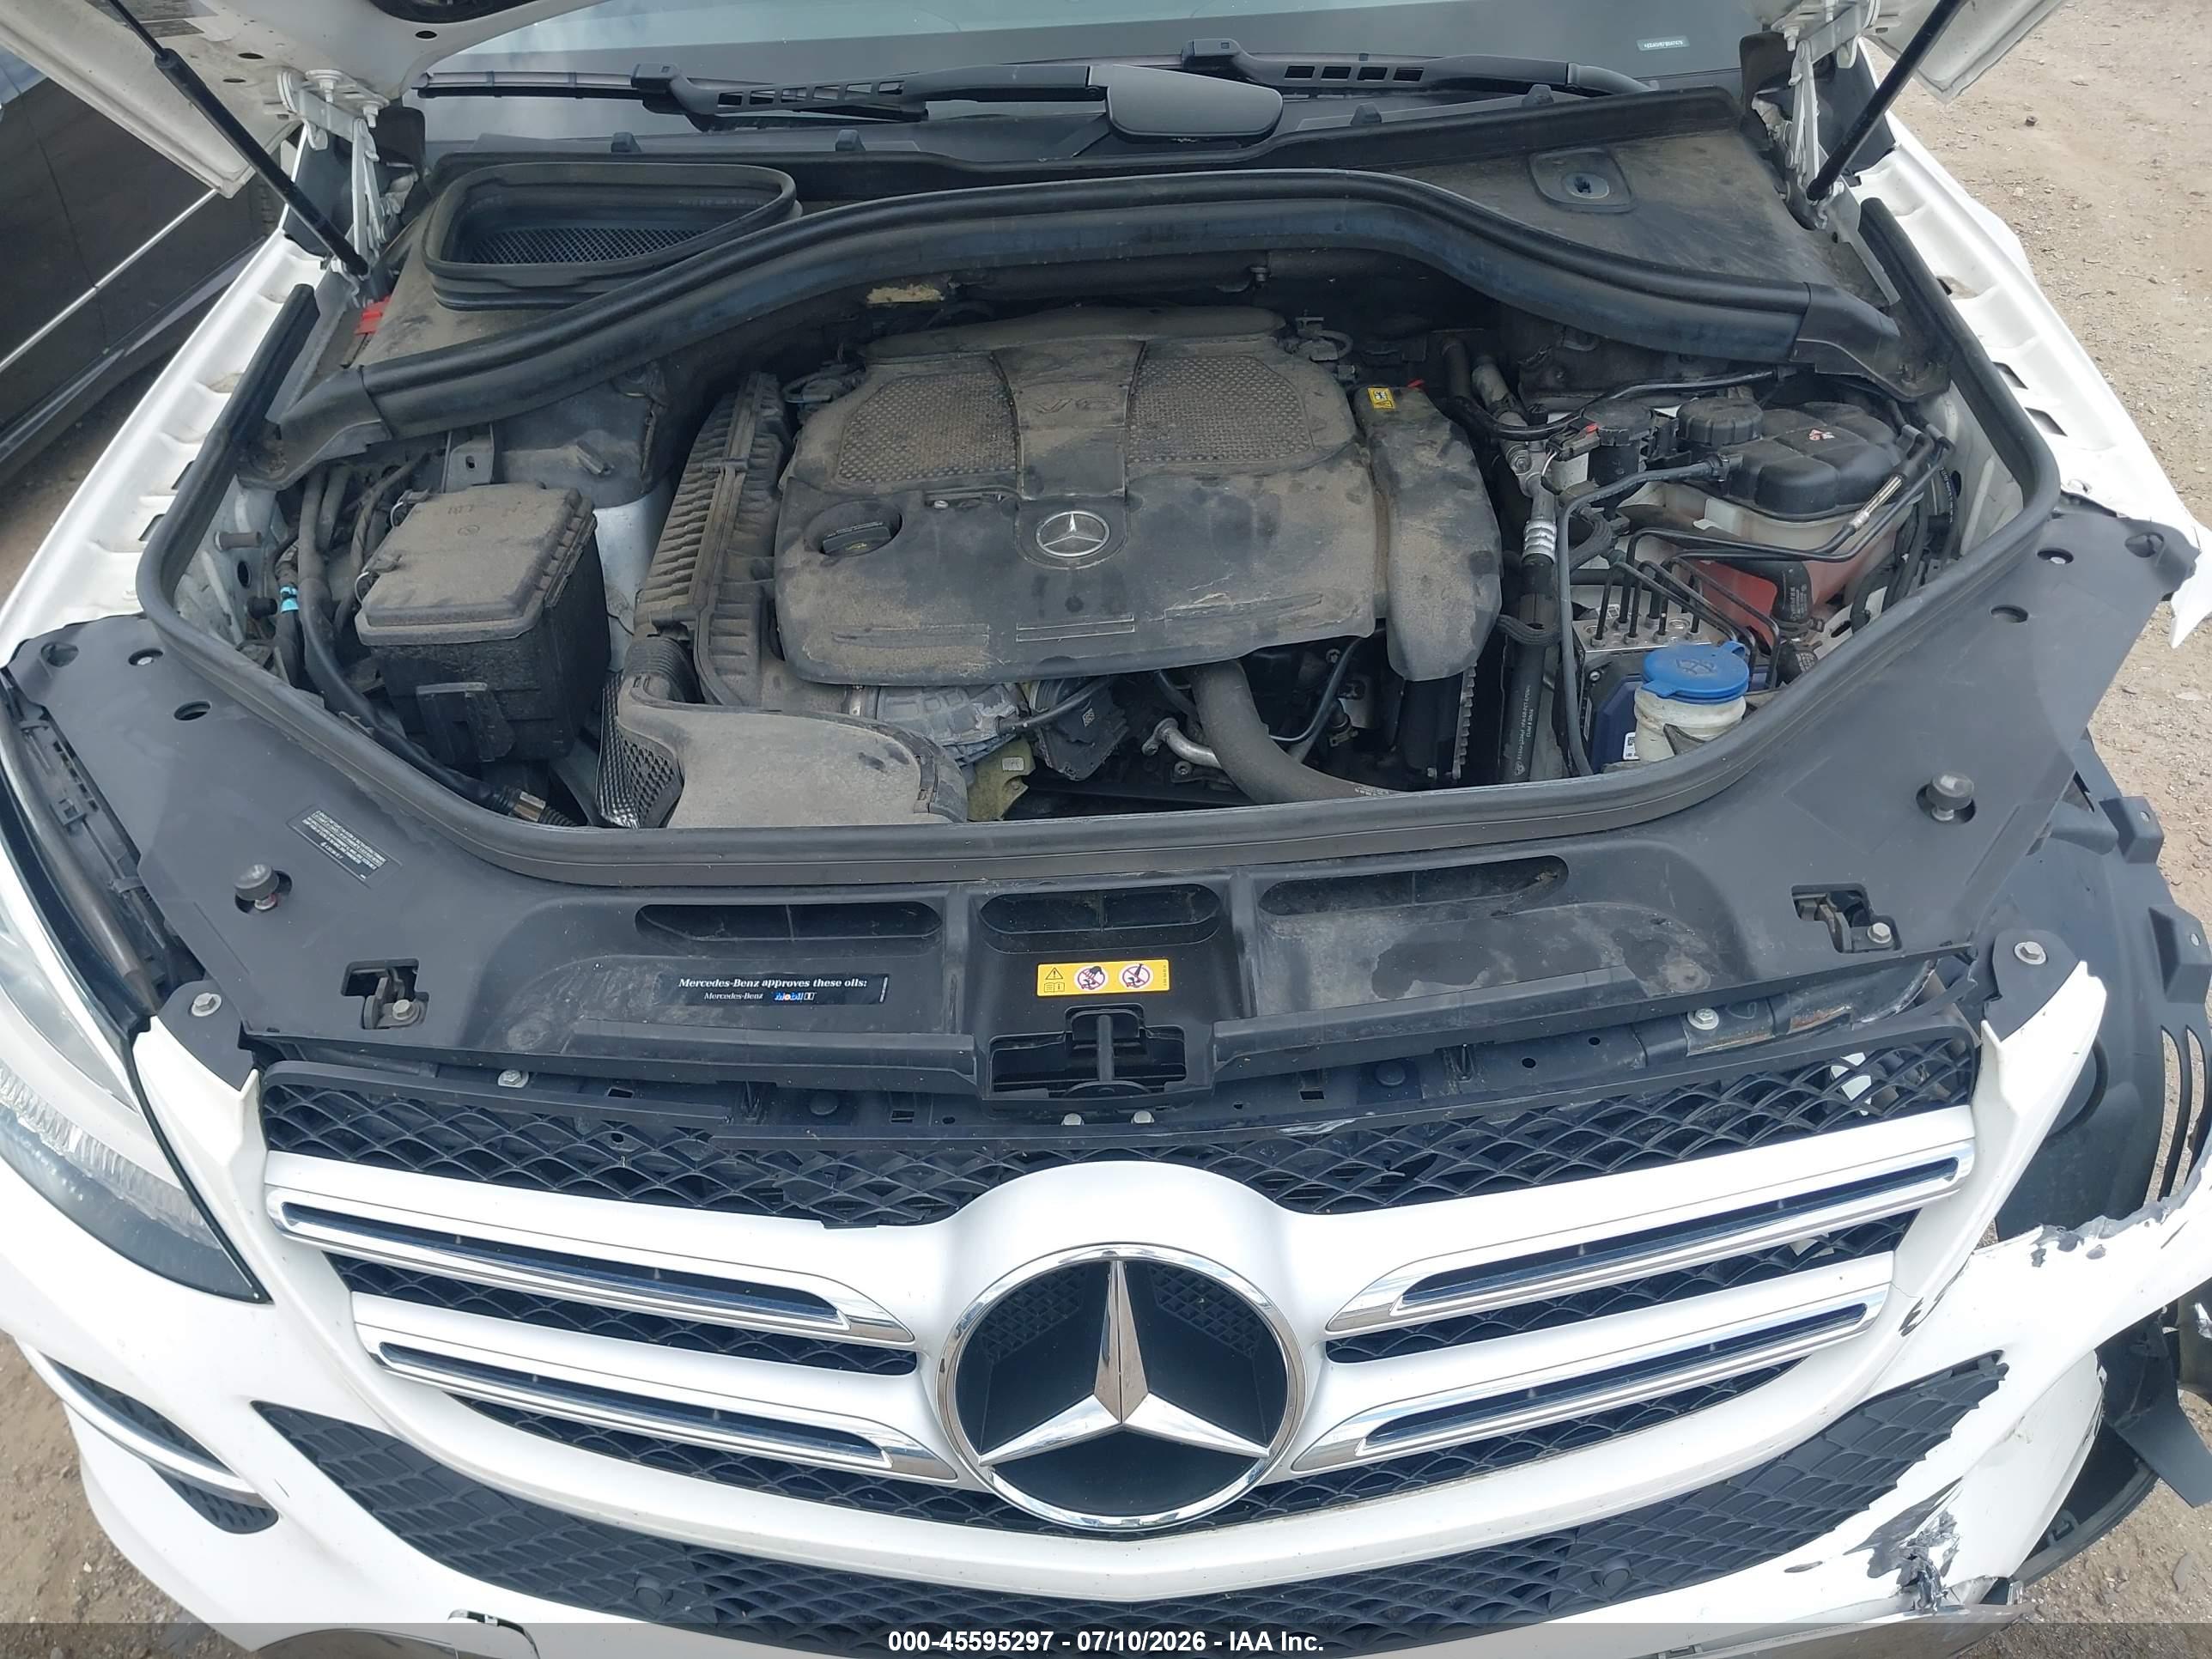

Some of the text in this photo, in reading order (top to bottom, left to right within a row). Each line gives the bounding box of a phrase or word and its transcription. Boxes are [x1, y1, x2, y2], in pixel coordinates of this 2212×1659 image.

[678, 977, 867, 990] Mercedes-Benz approves these oils:
[704, 992, 763, 1000] Mercedes-Benz
